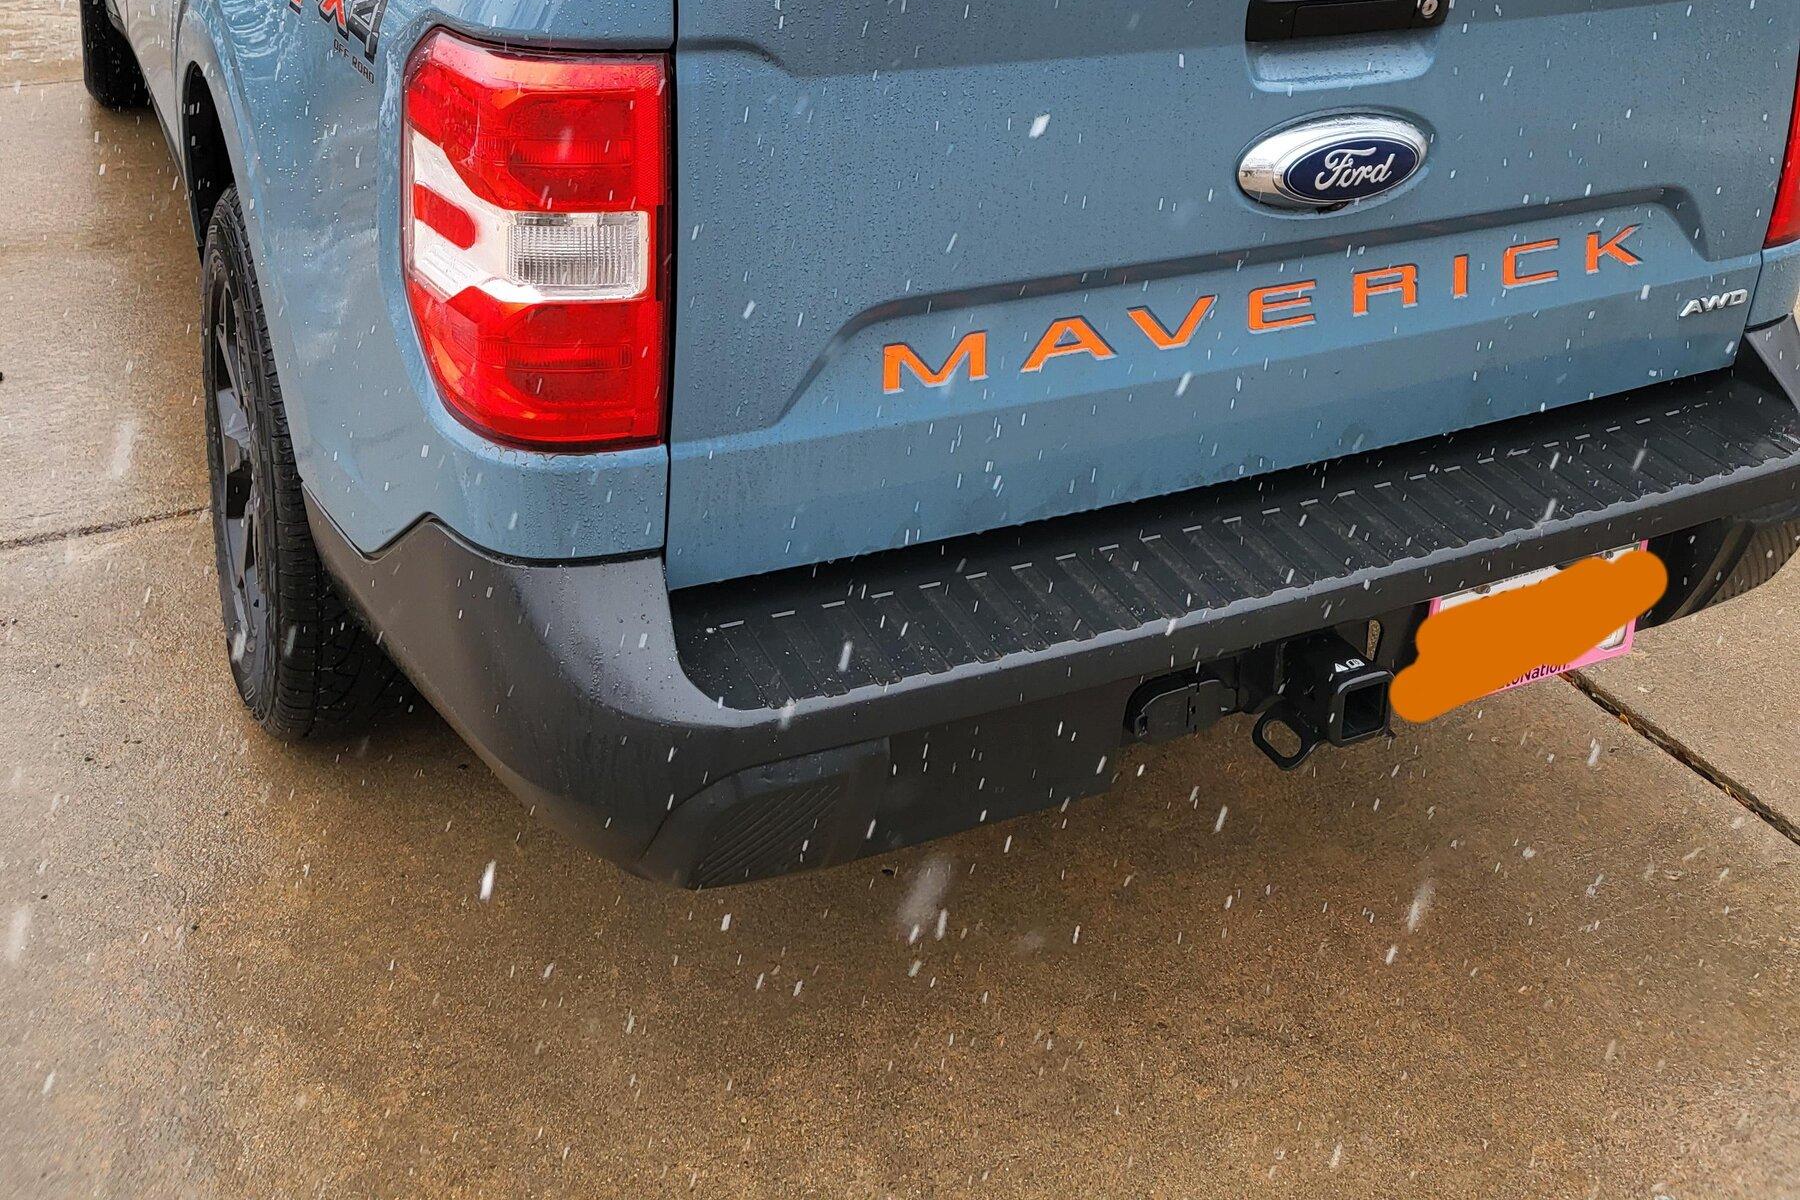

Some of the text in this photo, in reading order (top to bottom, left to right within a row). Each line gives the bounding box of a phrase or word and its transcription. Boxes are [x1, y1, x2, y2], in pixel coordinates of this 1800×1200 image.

[333, 38, 375, 84] OFF ROAD
[1314, 146, 1396, 191] Ford
[882, 223, 1643, 394] MAVERICK
[1679, 288, 1748, 317] AWD
